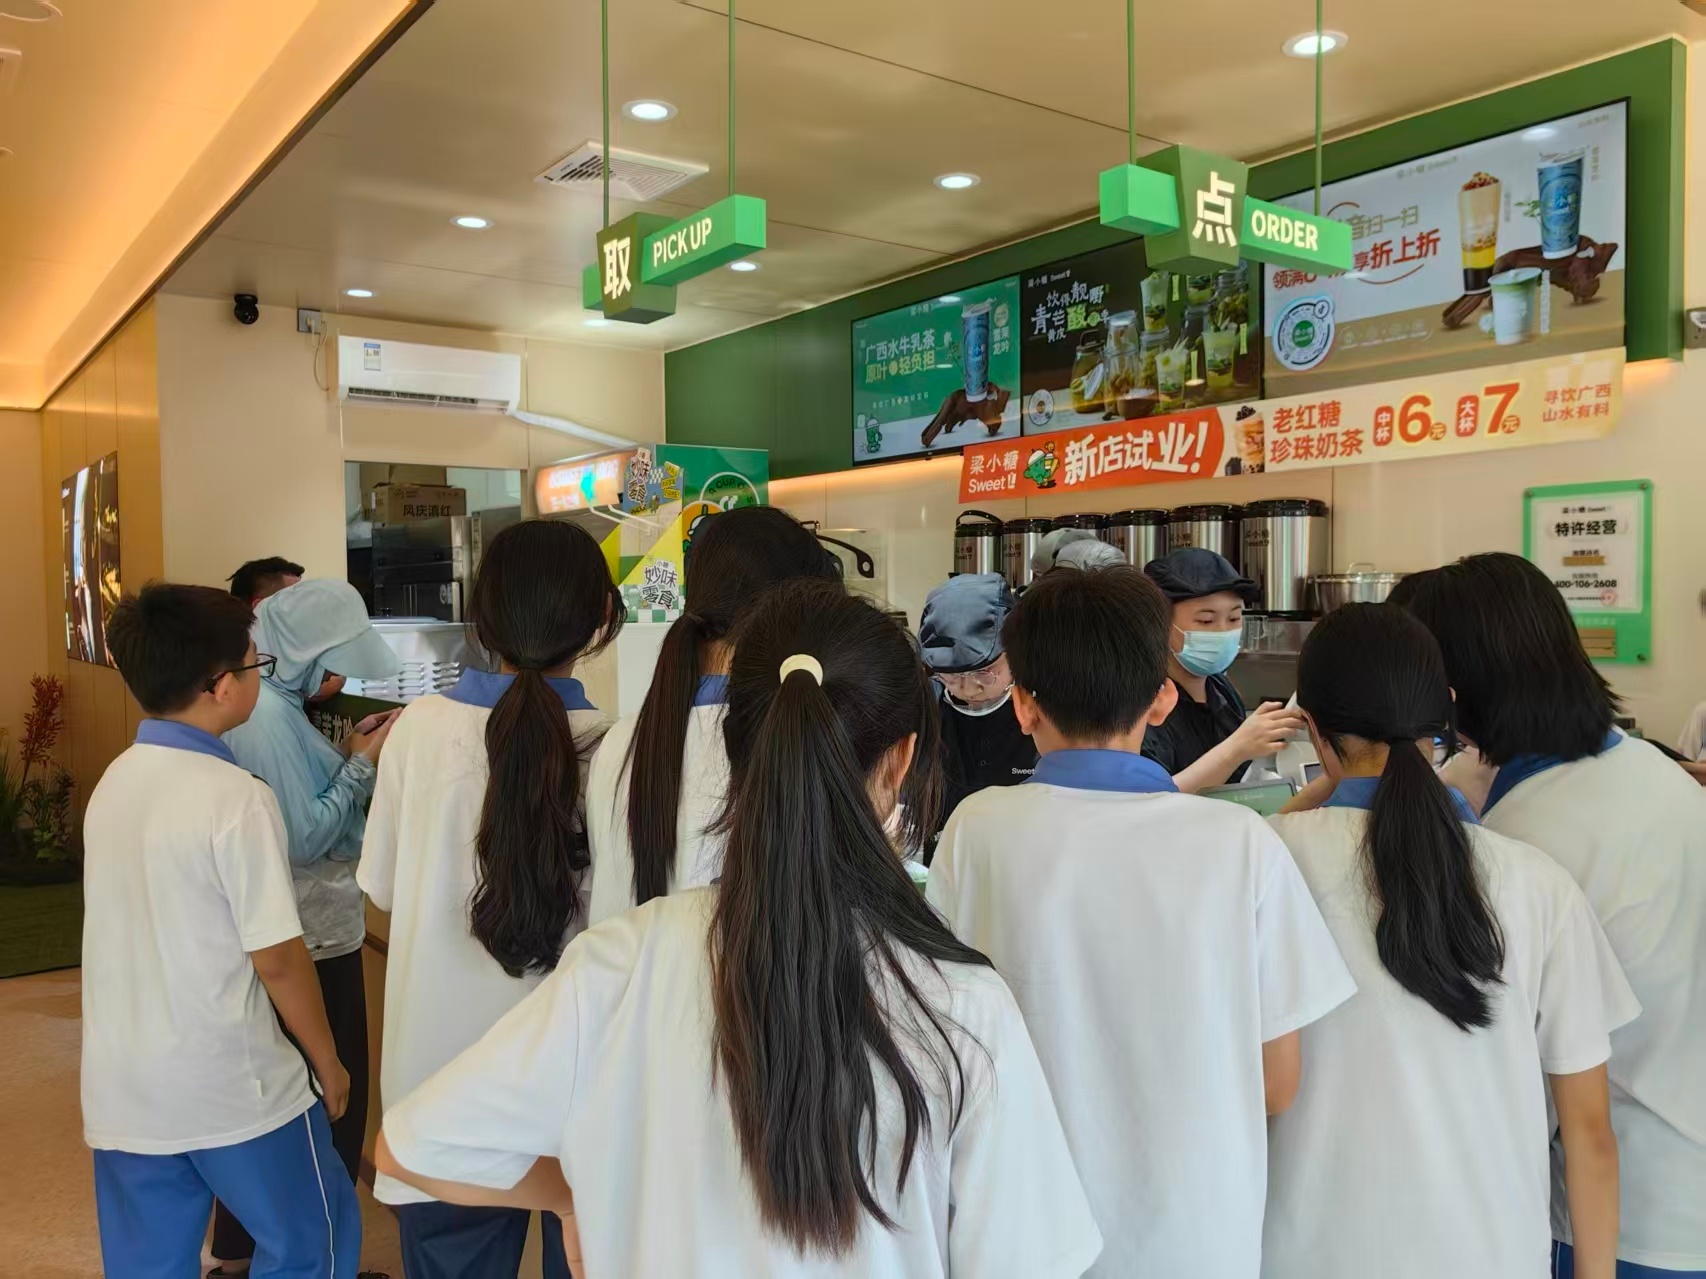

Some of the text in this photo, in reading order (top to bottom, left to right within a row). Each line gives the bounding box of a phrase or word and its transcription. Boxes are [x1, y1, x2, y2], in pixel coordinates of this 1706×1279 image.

[1192, 170, 1238, 248] 点
[653, 216, 712, 268] PICK UP
[1251, 208, 1318, 251] ORDER
[603, 236, 632, 300] 取
[865, 328, 936, 365] 广西水牛乳茶
[1543, 383, 1612, 405] 寻饮广西
[1273, 400, 1341, 433] 老红糖
[1376, 411, 1391, 442] 中杯
[1458, 400, 1475, 432] 大杯
[1542, 401, 1611, 423] 山水有料
[1269, 429, 1364, 464] 珍珠奶茶
[970, 450, 1019, 475] 梁小糖
[968, 476, 1006, 493] Sweet
[1555, 519, 1617, 537] 特许经营
[645, 565, 677, 588] 妙味
[642, 585, 675, 610] 零食
[1011, 767, 1035, 775] Sweet
